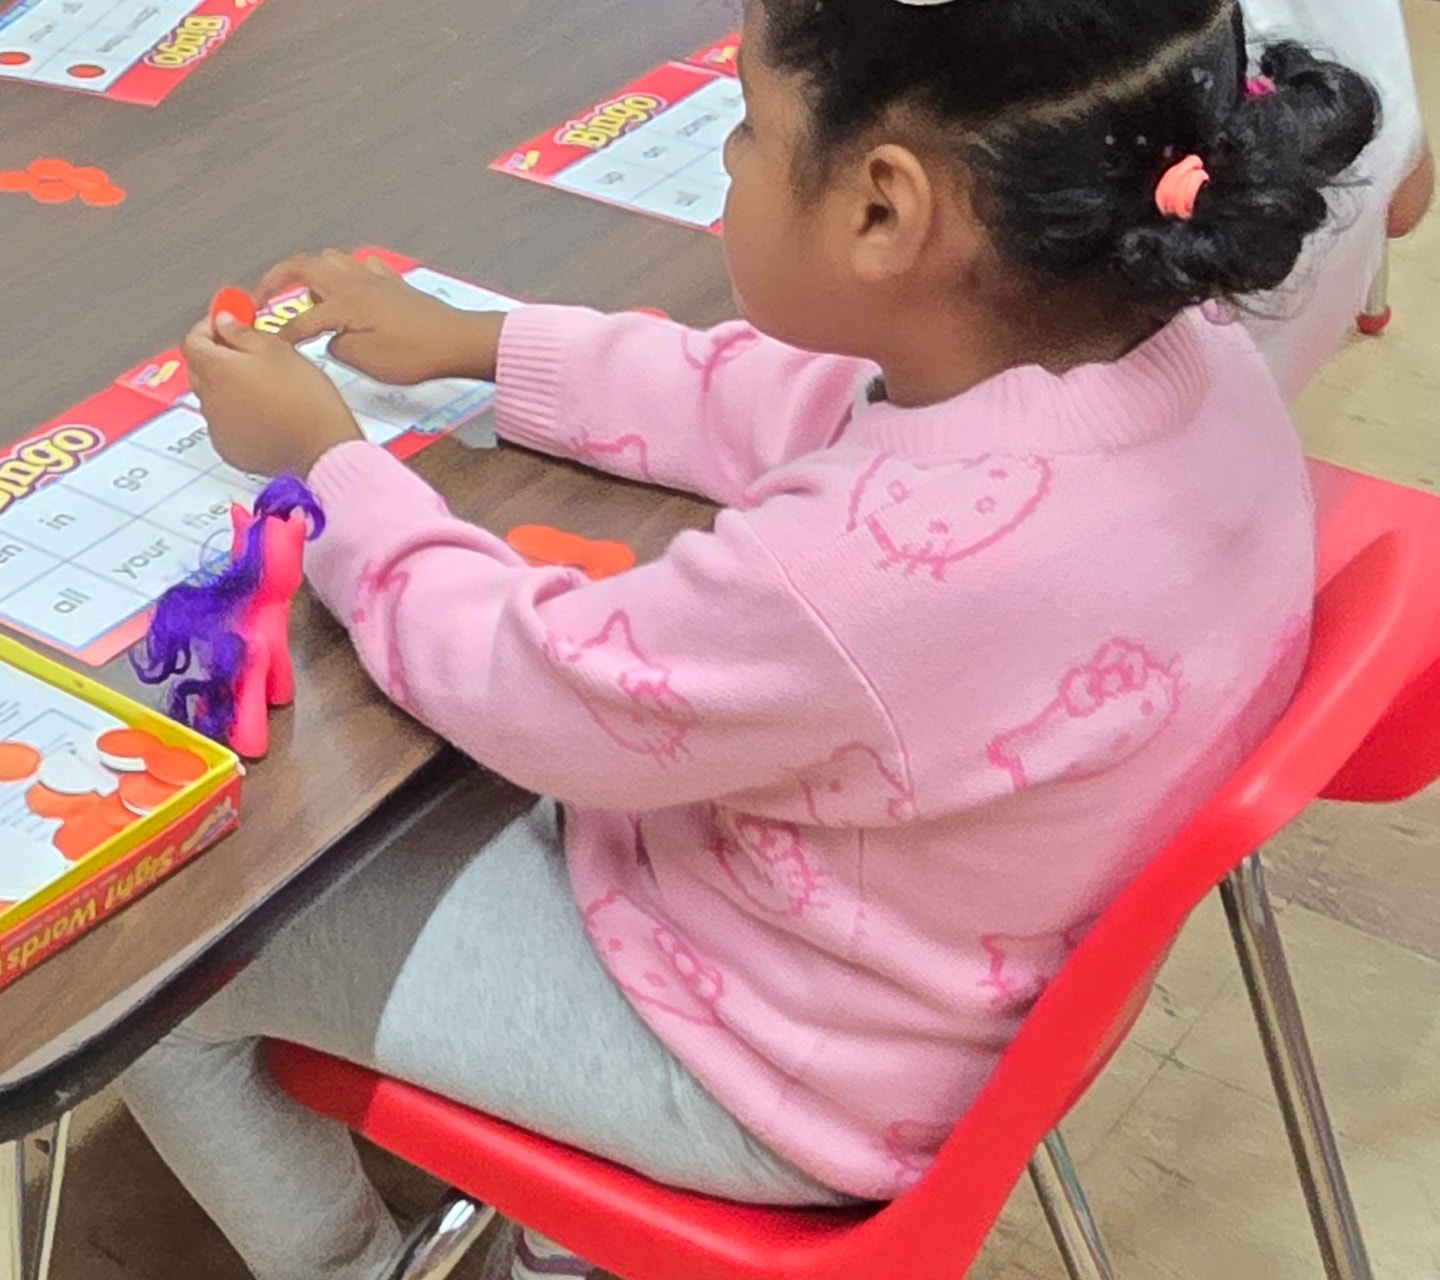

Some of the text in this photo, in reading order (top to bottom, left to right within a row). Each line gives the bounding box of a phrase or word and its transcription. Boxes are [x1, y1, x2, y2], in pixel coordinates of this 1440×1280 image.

[152, 15, 226, 65] Bingo
[560, 94, 663, 151] Bingo
[166, 426, 211, 457] som
[113, 466, 150, 493] go
[38, 512, 77, 532] in
[111, 537, 172, 581] your
[52, 586, 93, 615] all
[106, 845, 176, 909] Sight
[6, 898, 97, 971] Words
